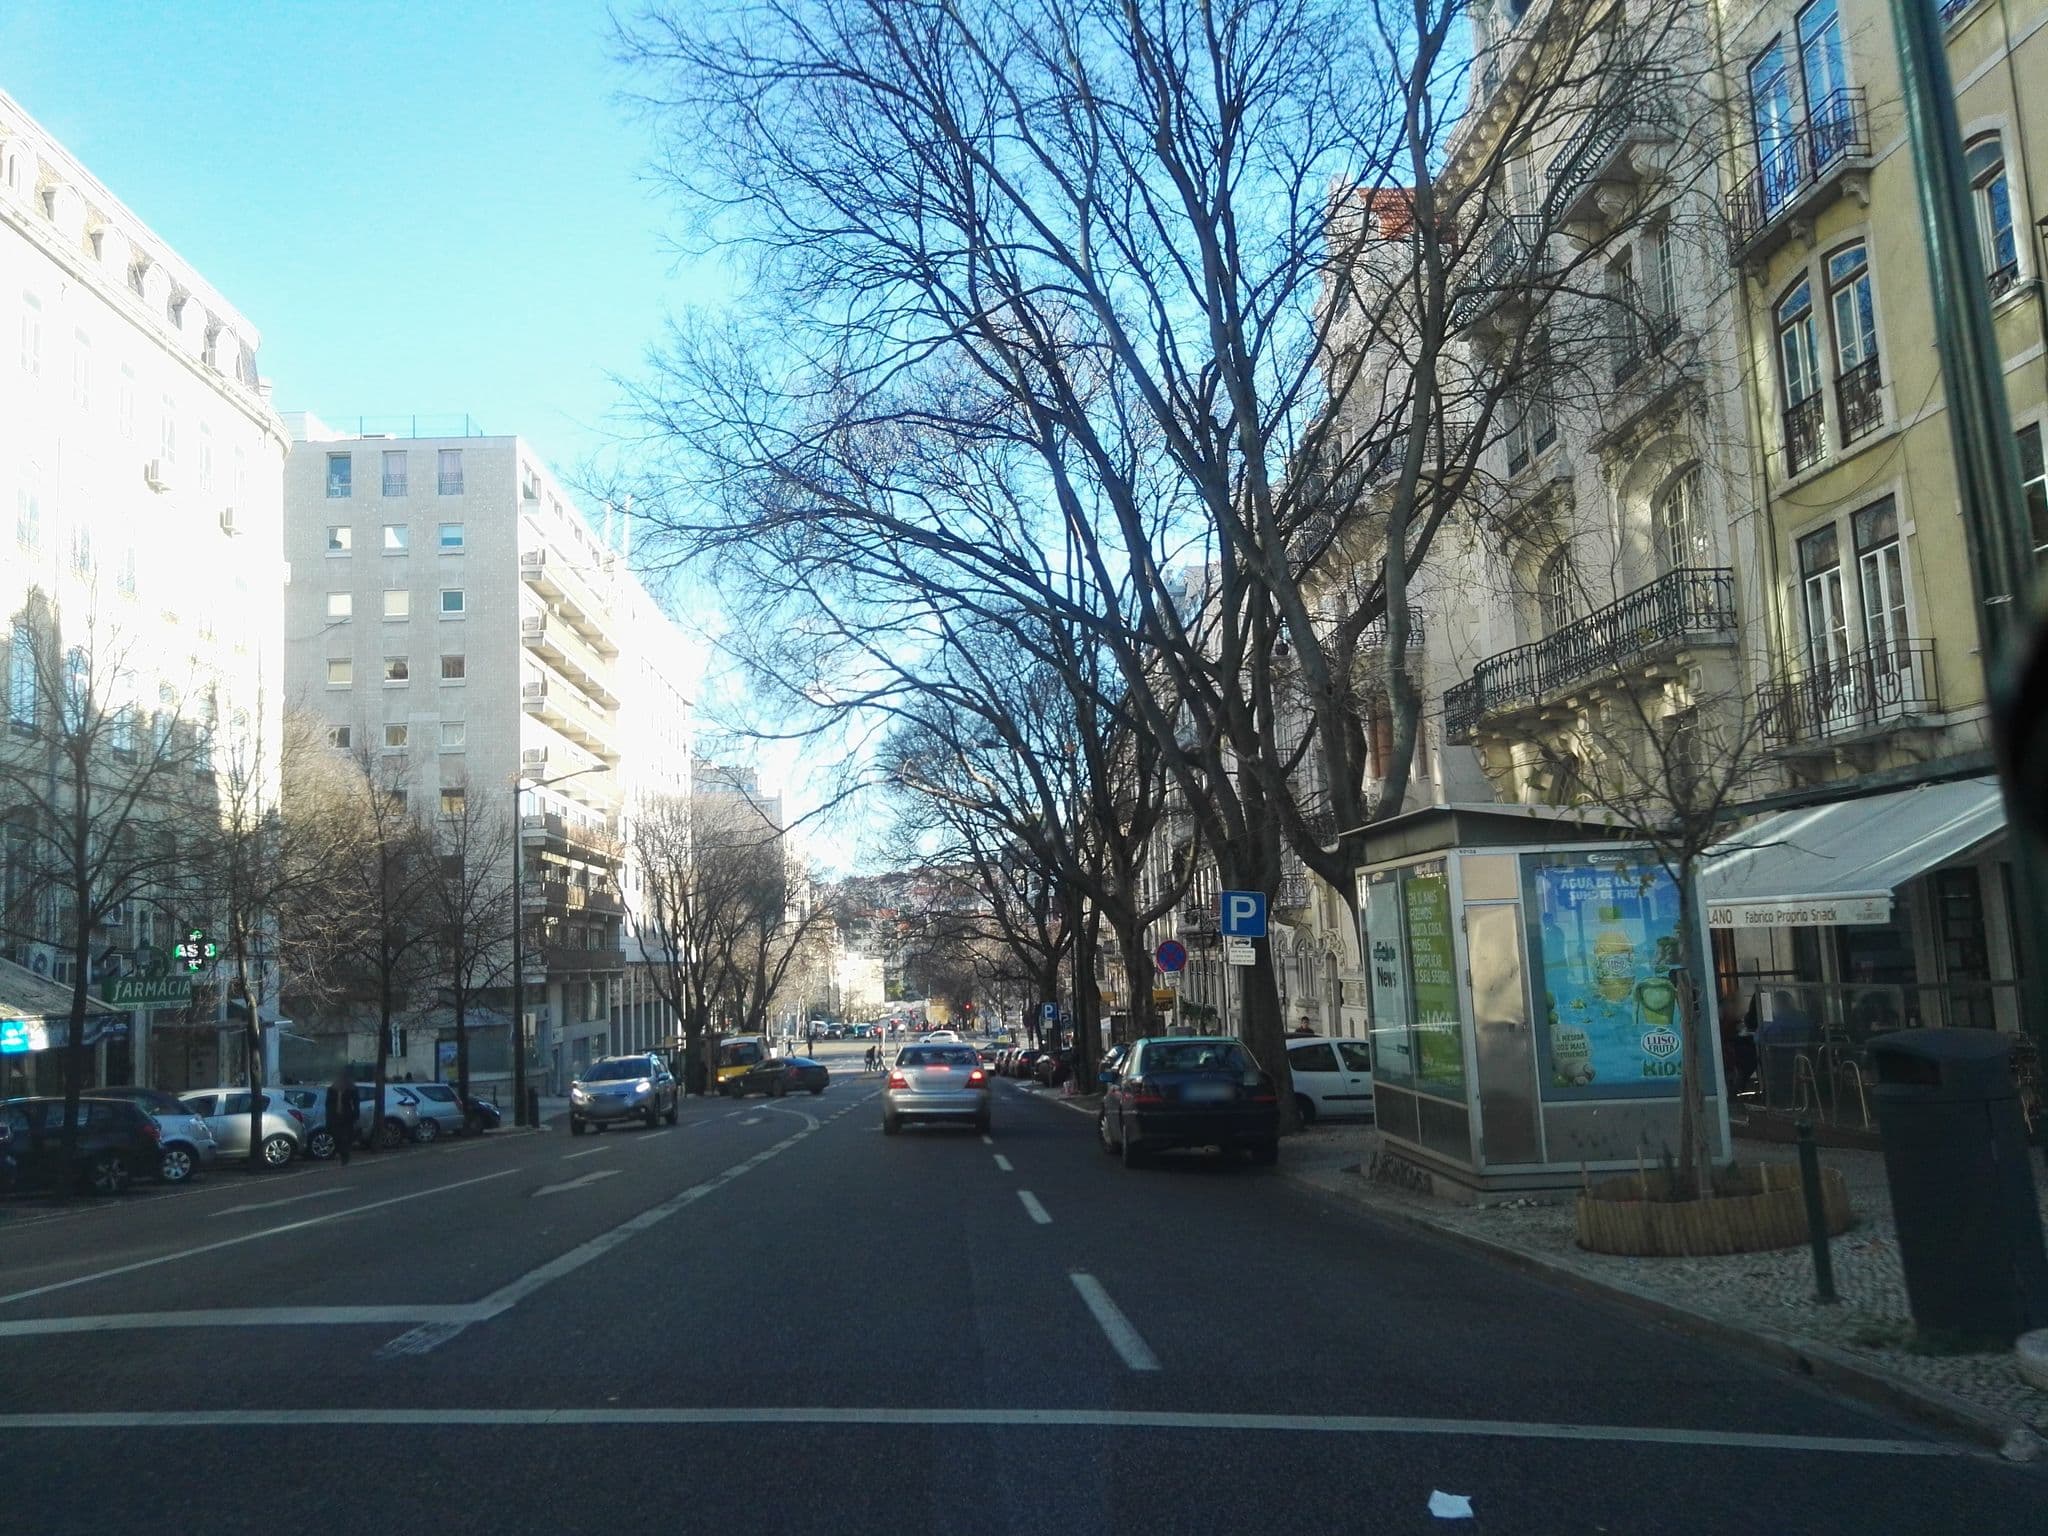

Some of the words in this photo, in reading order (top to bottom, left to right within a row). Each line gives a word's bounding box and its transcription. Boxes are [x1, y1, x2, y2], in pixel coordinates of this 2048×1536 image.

[1230, 895, 1257, 931] P
[1745, 911, 1774, 924] Fabrico
[1811, 908, 1837, 922] Snack
[1377, 967, 1396, 988] News
[1044, 1004, 1054, 1017] P
[1647, 1035, 1675, 1045] LUSO
[1648, 1045, 1675, 1054] FRUTA
